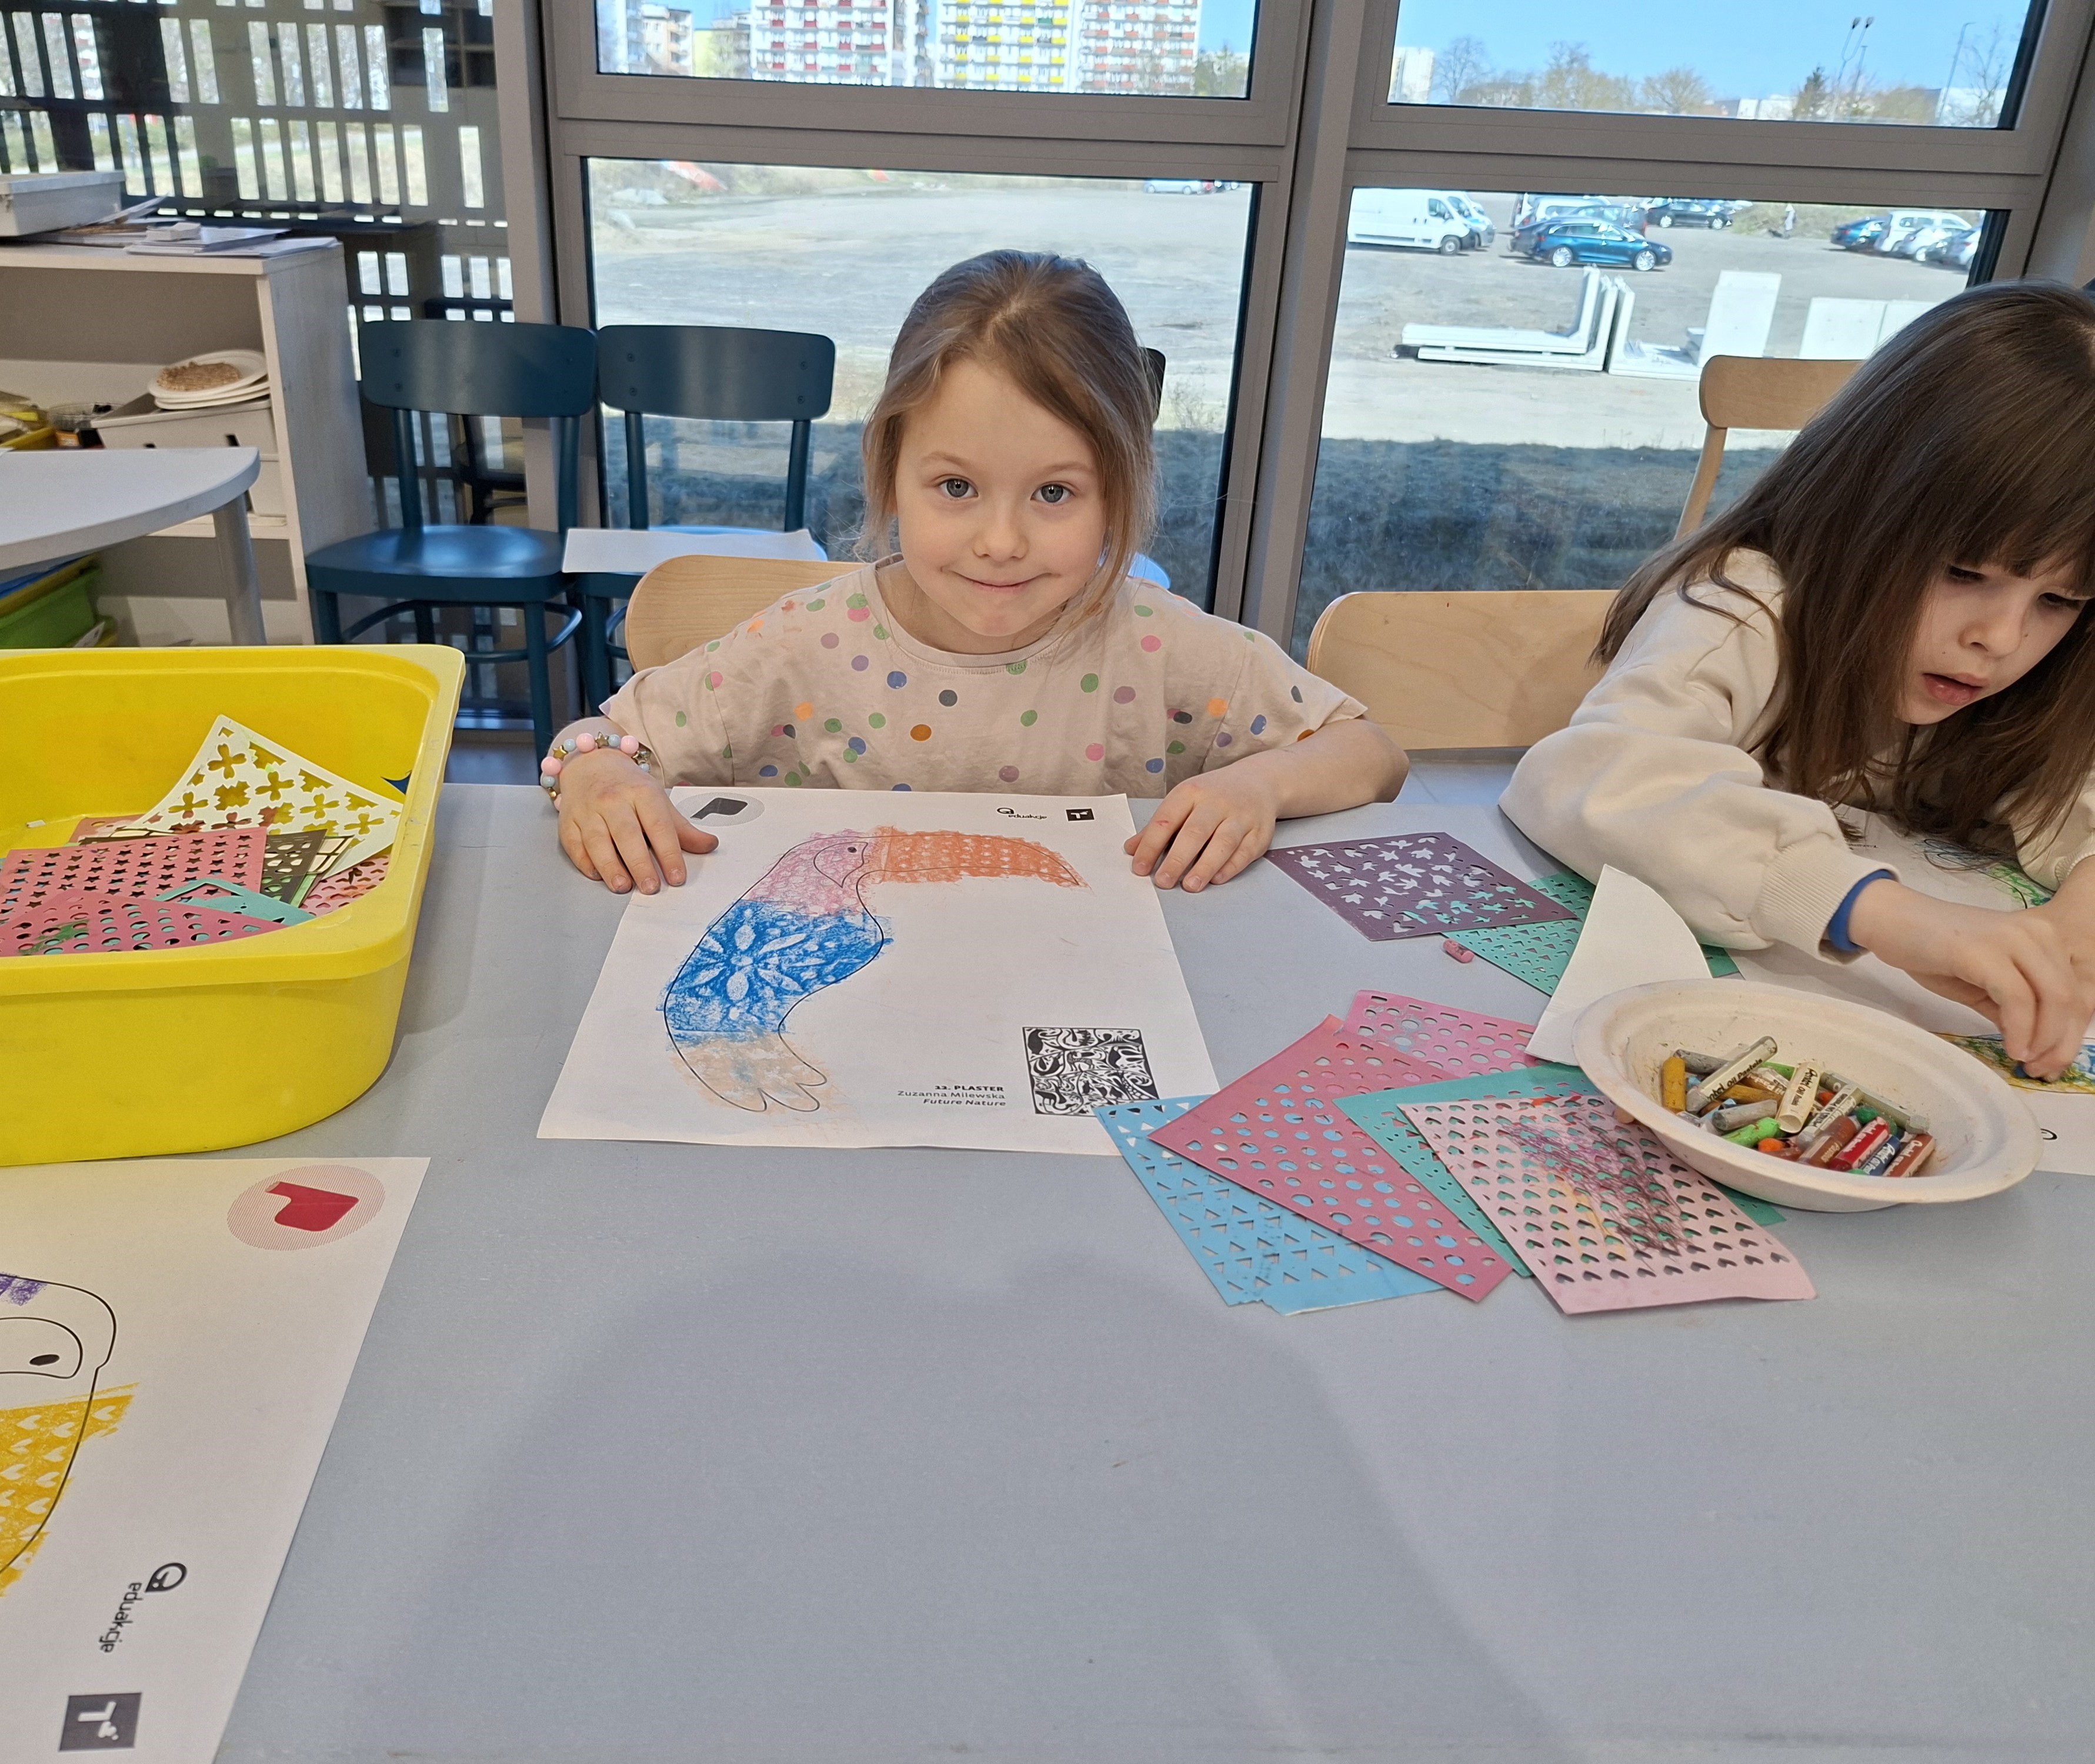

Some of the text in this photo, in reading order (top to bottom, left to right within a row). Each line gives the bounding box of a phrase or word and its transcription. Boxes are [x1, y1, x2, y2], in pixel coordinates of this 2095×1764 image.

[1706, 1058, 1763, 1101] ntel Oil Pastels
[98, 1582, 144, 1653] eduakcje
